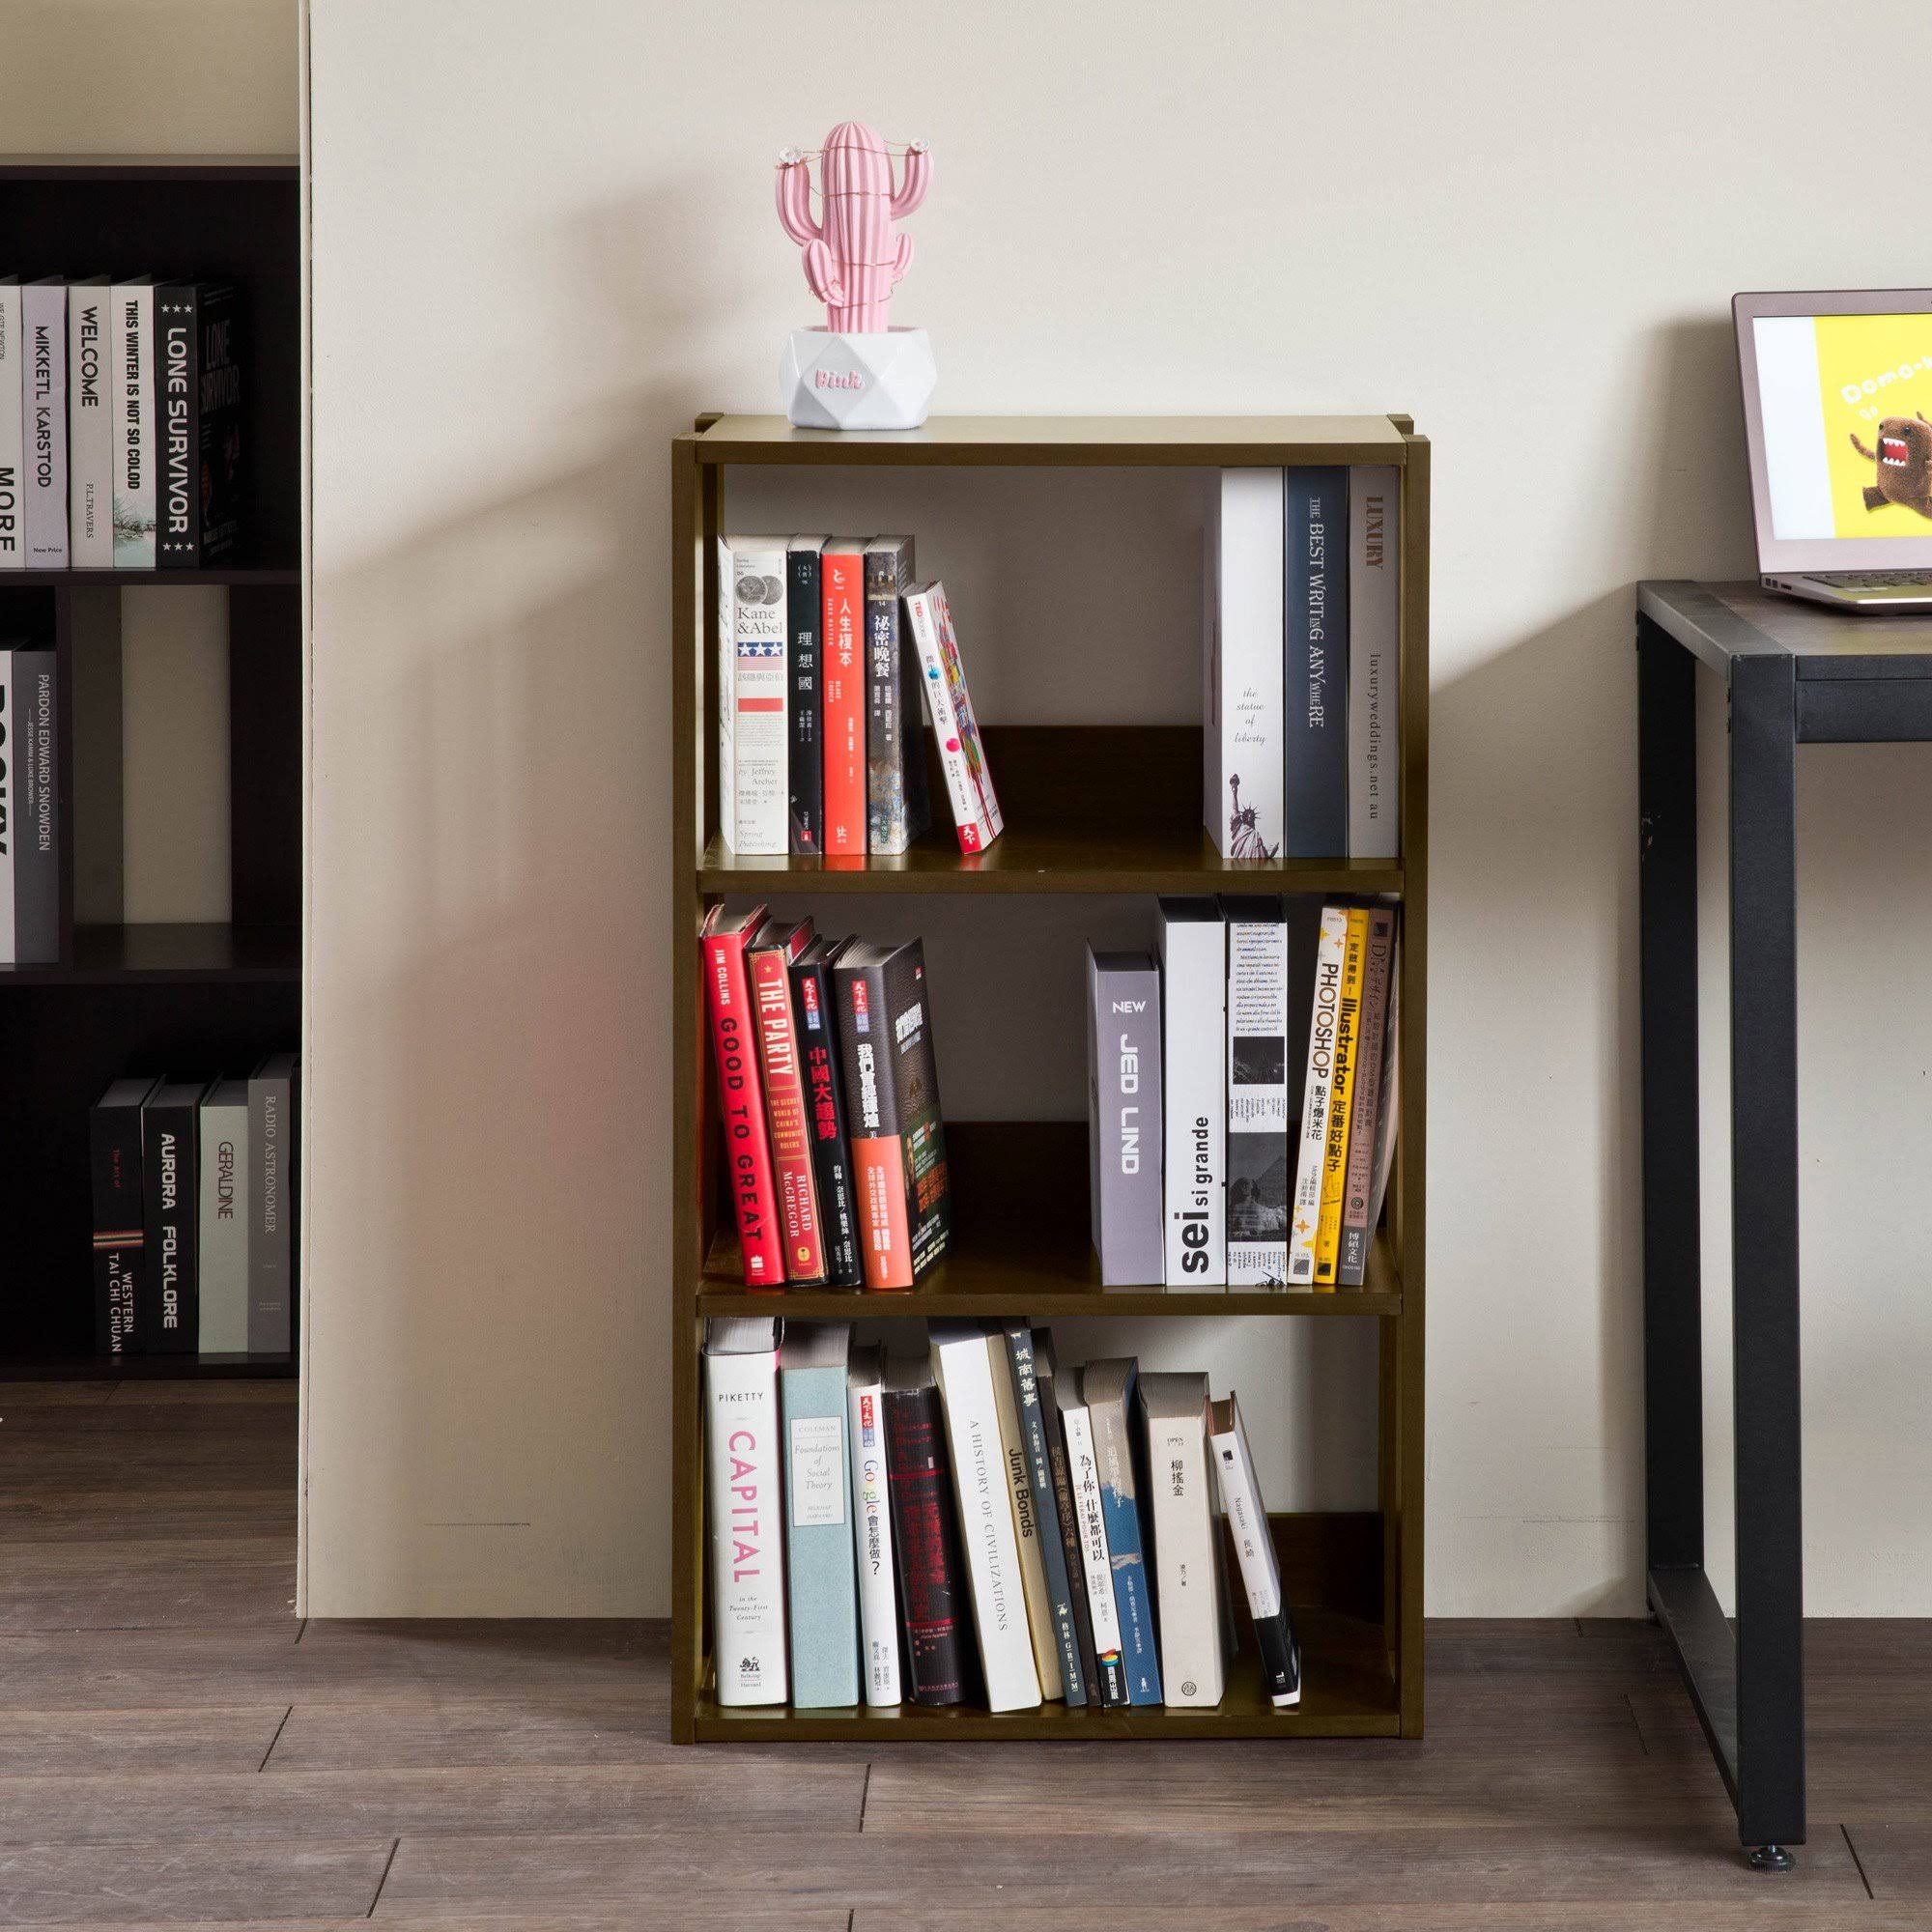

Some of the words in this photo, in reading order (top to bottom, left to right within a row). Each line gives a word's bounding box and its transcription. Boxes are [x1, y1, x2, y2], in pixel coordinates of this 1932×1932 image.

[126, 299, 138, 329] THIS
[36, 326, 51, 400] MIKKETL
[81, 306, 99, 408] WELCOME
[127, 332, 139, 381] WINTER
[167, 327, 187, 392] LONE
[815, 370, 865, 390] Pink
[127, 383, 139, 396] IS
[127, 400, 139, 424] NOT
[37, 407, 52, 488] KARSTOD
[128, 427, 140, 445] SO
[128, 448, 140, 490] COLOD
[168, 400, 187, 532] SURVIVOR
[1310, 497, 1321, 518] THE
[1309, 523, 1323, 569] BEST
[1366, 497, 1383, 570] LUXURY
[737, 622, 782, 635] &Abel
[738, 607, 776, 620] Kane
[914, 602, 923, 617] TED
[1309, 574, 1326, 640] WRITING
[798, 632, 812, 690] 理想國
[39, 674, 49, 724] PARDON
[1242, 687, 1258, 698] the
[1309, 646, 1326, 728] ANYWHERE
[1235, 732, 1266, 748] liberty
[1245, 714, 1256, 728] of
[39, 727, 49, 781] EDWARD
[39, 786, 50, 851] SNOWDEN
[718, 967, 731, 1006] COLLINS
[758, 979, 786, 1013] THE
[804, 978, 817, 1010] 天下文化
[853, 981, 867, 1013] 天下文化
[1112, 1001, 1147, 1013] NEW
[1312, 962, 1339, 1079] PHOTOSHOP
[720, 1017, 744, 1091] GOOD
[763, 1017, 794, 1075] PARTY
[1121, 1034, 1139, 1094] JED
[1333, 997, 1358, 1095] Illustrator
[265, 1095, 276, 1138] RADIO
[731, 1105, 751, 1139] TO
[1121, 1107, 1139, 1175] LIND
[1326, 1100, 1347, 1173] 定番好點子
[161, 1133, 176, 1209] AURORA
[1191, 1117, 1212, 1184] grande
[217, 1141, 234, 1220] GERALDINE
[265, 1143, 276, 1234] ASTRONOMER
[737, 1154, 762, 1241] GREAT
[782, 1171, 800, 1237] McGREGOR
[796, 1175, 812, 1231] RICHARD
[1191, 1190, 1208, 1207] si
[109, 1253, 119, 1273] TAI
[1173, 1212, 1209, 1273] sei
[109, 1280, 121, 1300] CHI
[162, 1226, 177, 1328] FOLKLORE
[123, 1271, 133, 1333] WESTERN
[110, 1306, 122, 1352] CHUAN
[719, 1392, 764, 1402] PIKETTY
[1015, 1348, 1037, 1407] 城南舊事
[794, 1443, 842, 1455] Foundations
[970, 1420, 980, 1430] A
[807, 1468, 831, 1478] Social
[813, 1455, 822, 1466] of
[972, 1433, 989, 1496] HISTORY
[1009, 1448, 1025, 1484] Junk
[1171, 1460, 1184, 1496] 柳搖金
[728, 1431, 761, 1583] CAPITAL
[805, 1480, 833, 1491] Theory
[862, 1459, 881, 1513] Google
[981, 1500, 993, 1520] OF
[1015, 1490, 1034, 1539] Bonds
[1235, 1497, 1247, 1530] Nagasaki
[984, 1524, 1009, 1632] CIVILIZATIONS
[736, 1614, 761, 1623] Century
[1065, 1641, 1079, 1692] GRIMM
